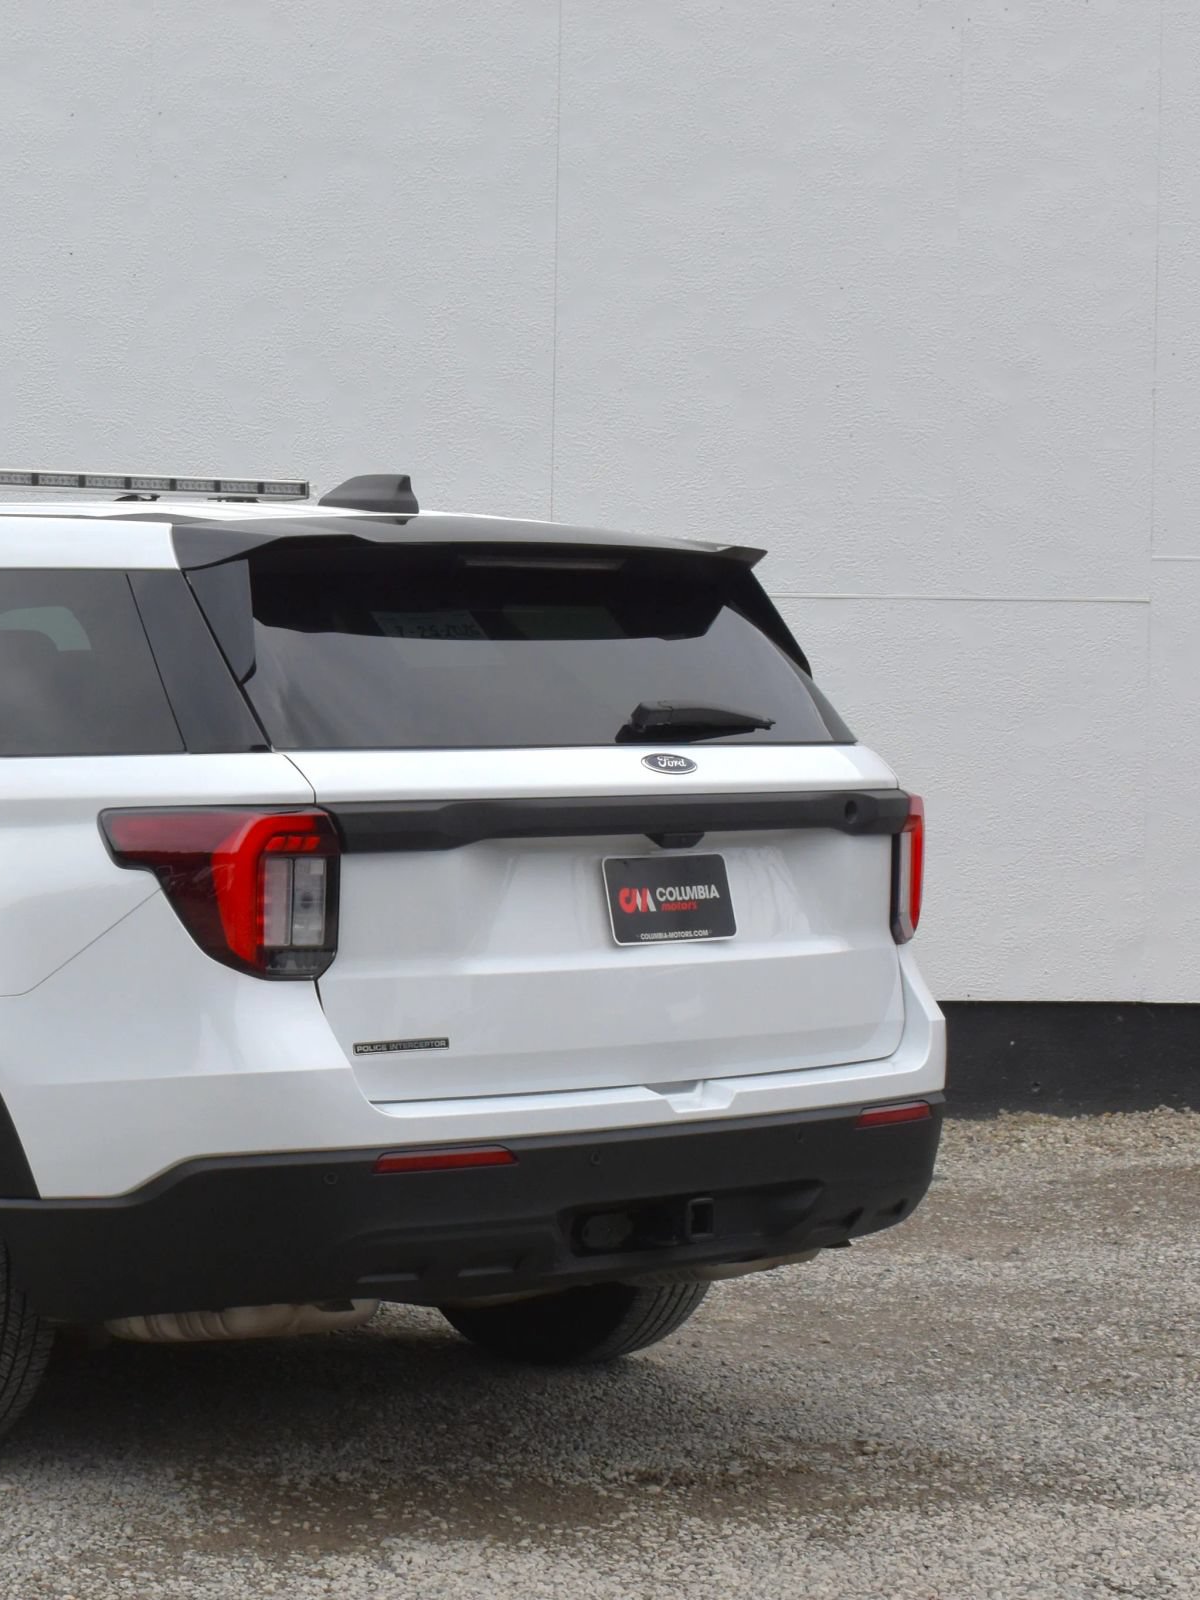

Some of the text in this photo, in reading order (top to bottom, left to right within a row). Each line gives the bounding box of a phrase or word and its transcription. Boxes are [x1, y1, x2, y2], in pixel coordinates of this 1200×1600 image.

[656, 756, 687, 768] Ford
[656, 884, 720, 902] COLUMBIA
[356, 1039, 447, 1053] POLICE INTERCEPTOR
